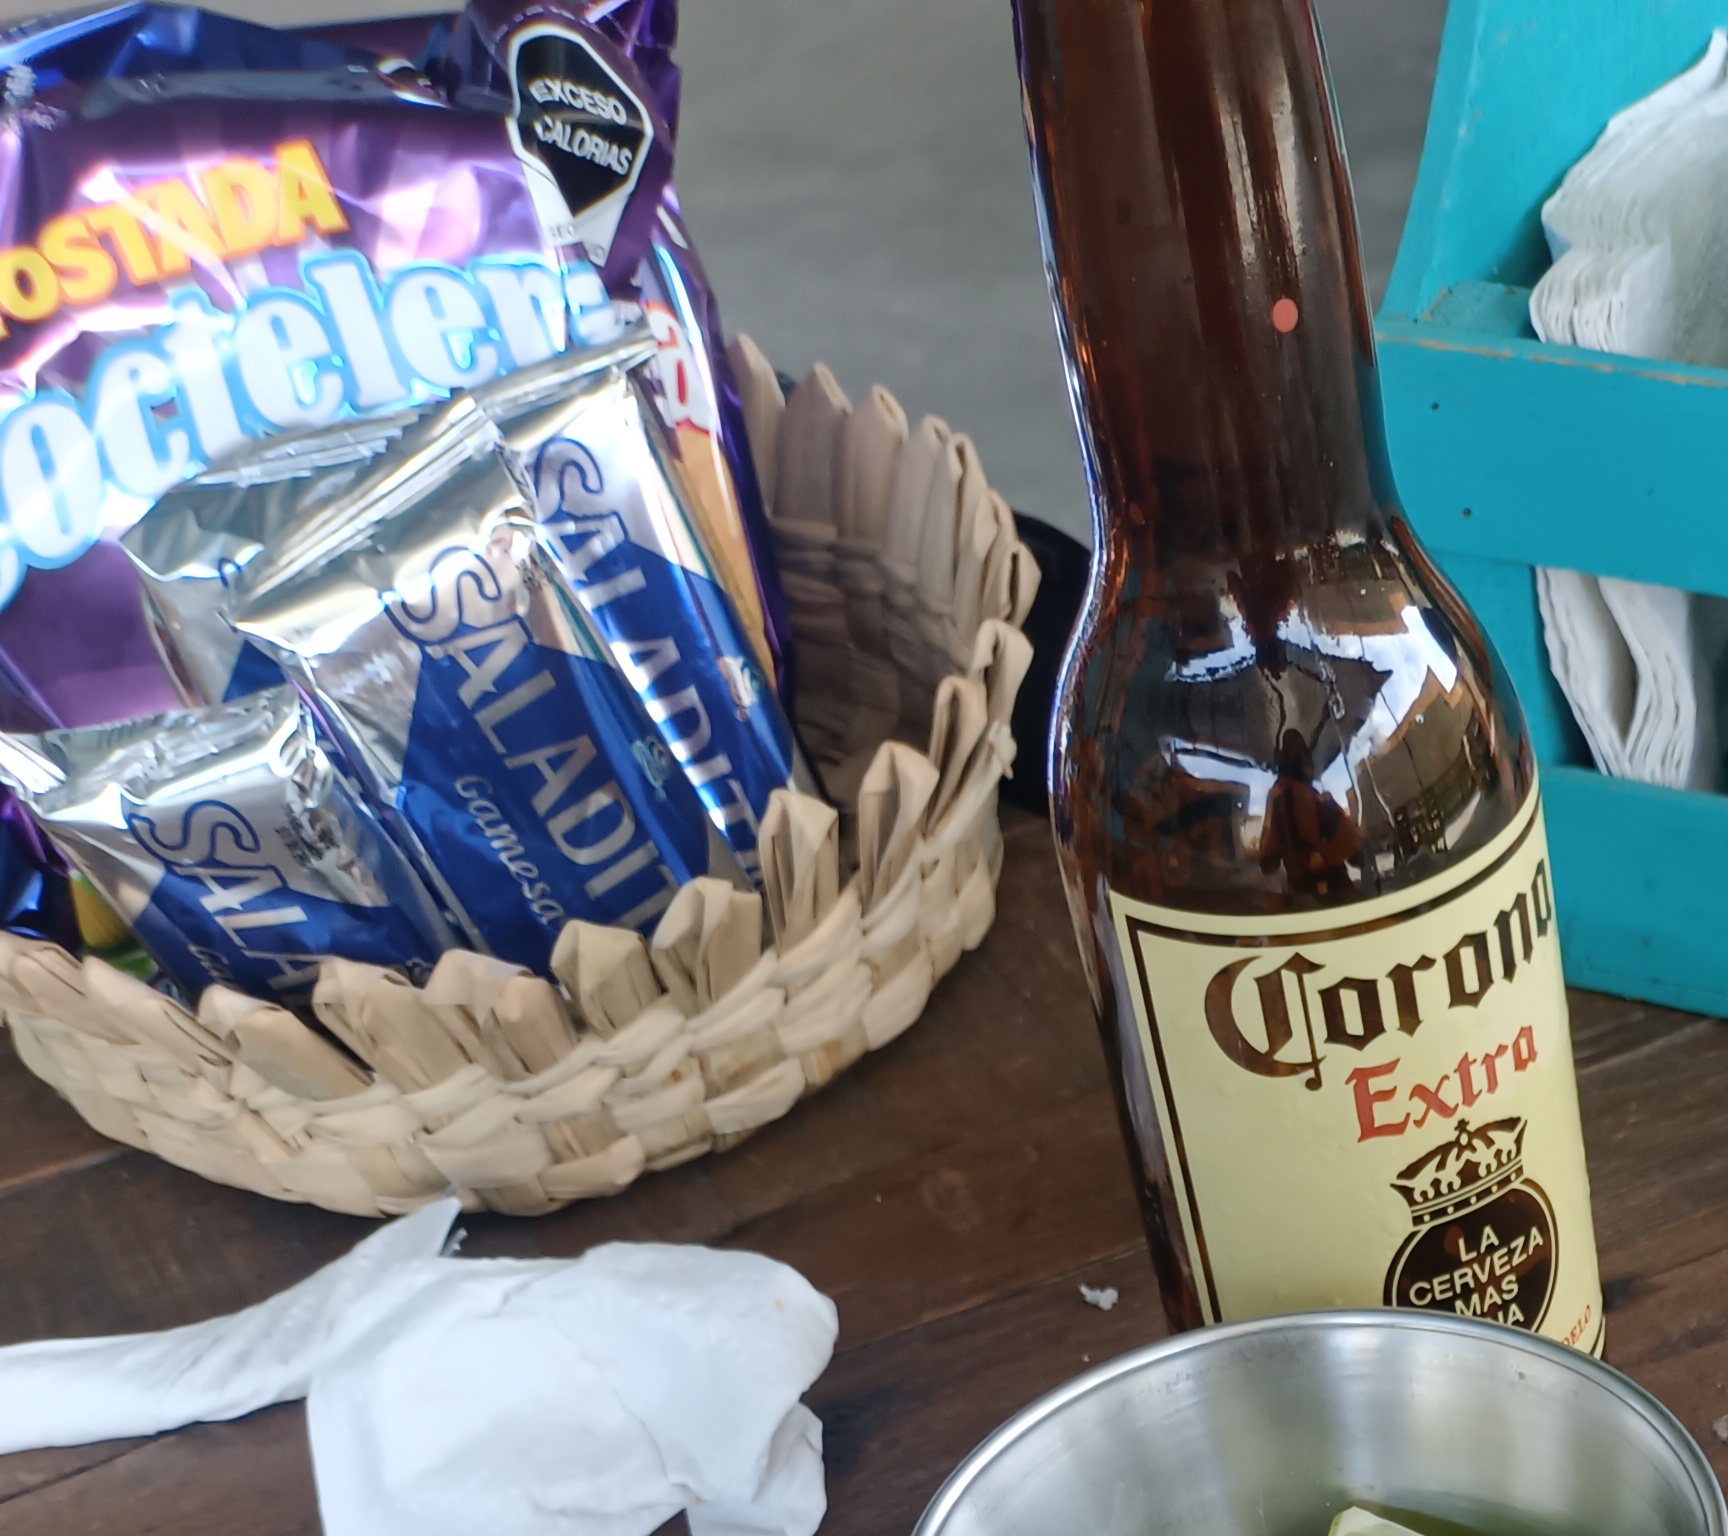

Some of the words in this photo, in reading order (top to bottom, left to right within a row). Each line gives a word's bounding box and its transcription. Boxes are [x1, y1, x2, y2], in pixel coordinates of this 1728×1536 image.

[528, 77, 628, 126] EXCESO
[533, 114, 632, 175] CALORIAS
[0, 142, 350, 342] OSTADA
[1204, 858, 1553, 1092] Corona
[1344, 1024, 1539, 1143] Extra
[1408, 1226, 1545, 1307] CERVEZA
[1458, 1224, 1500, 1263] LA
[1454, 1274, 1520, 1318] MAS
